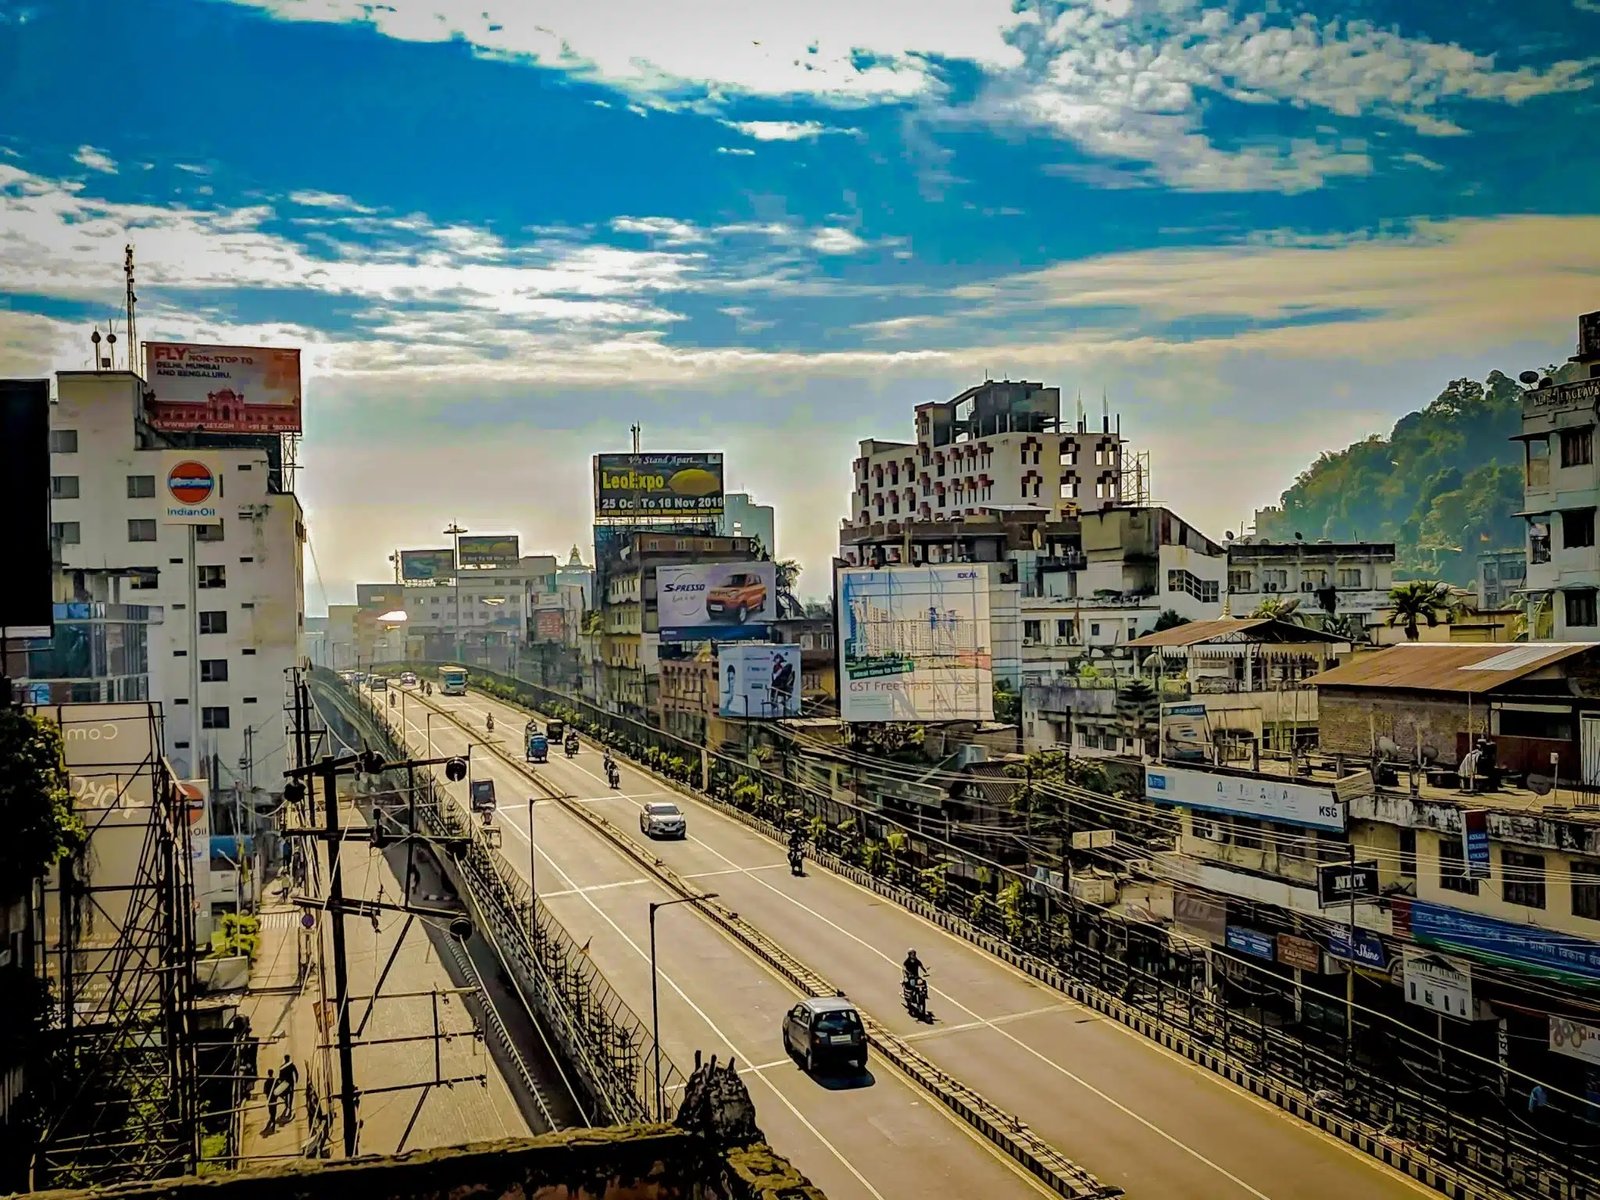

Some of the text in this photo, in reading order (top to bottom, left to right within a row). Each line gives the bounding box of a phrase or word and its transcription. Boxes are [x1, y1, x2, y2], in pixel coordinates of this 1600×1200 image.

[154, 346, 253, 365] FLY NON-STOP TO
[643, 454, 669, 464] Stand
[602, 471, 664, 492] LeoExpo
[602, 498, 616, 509] 25
[641, 498, 656, 509] To
[674, 497, 696, 508] Nov
[167, 507, 216, 516] IndianOil
[957, 572, 978, 580] IDEAL
[663, 583, 706, 593] S-PRESSO
[850, 682, 871, 692] GST
[875, 681, 900, 692] Free
[1319, 805, 1338, 818] KSG
